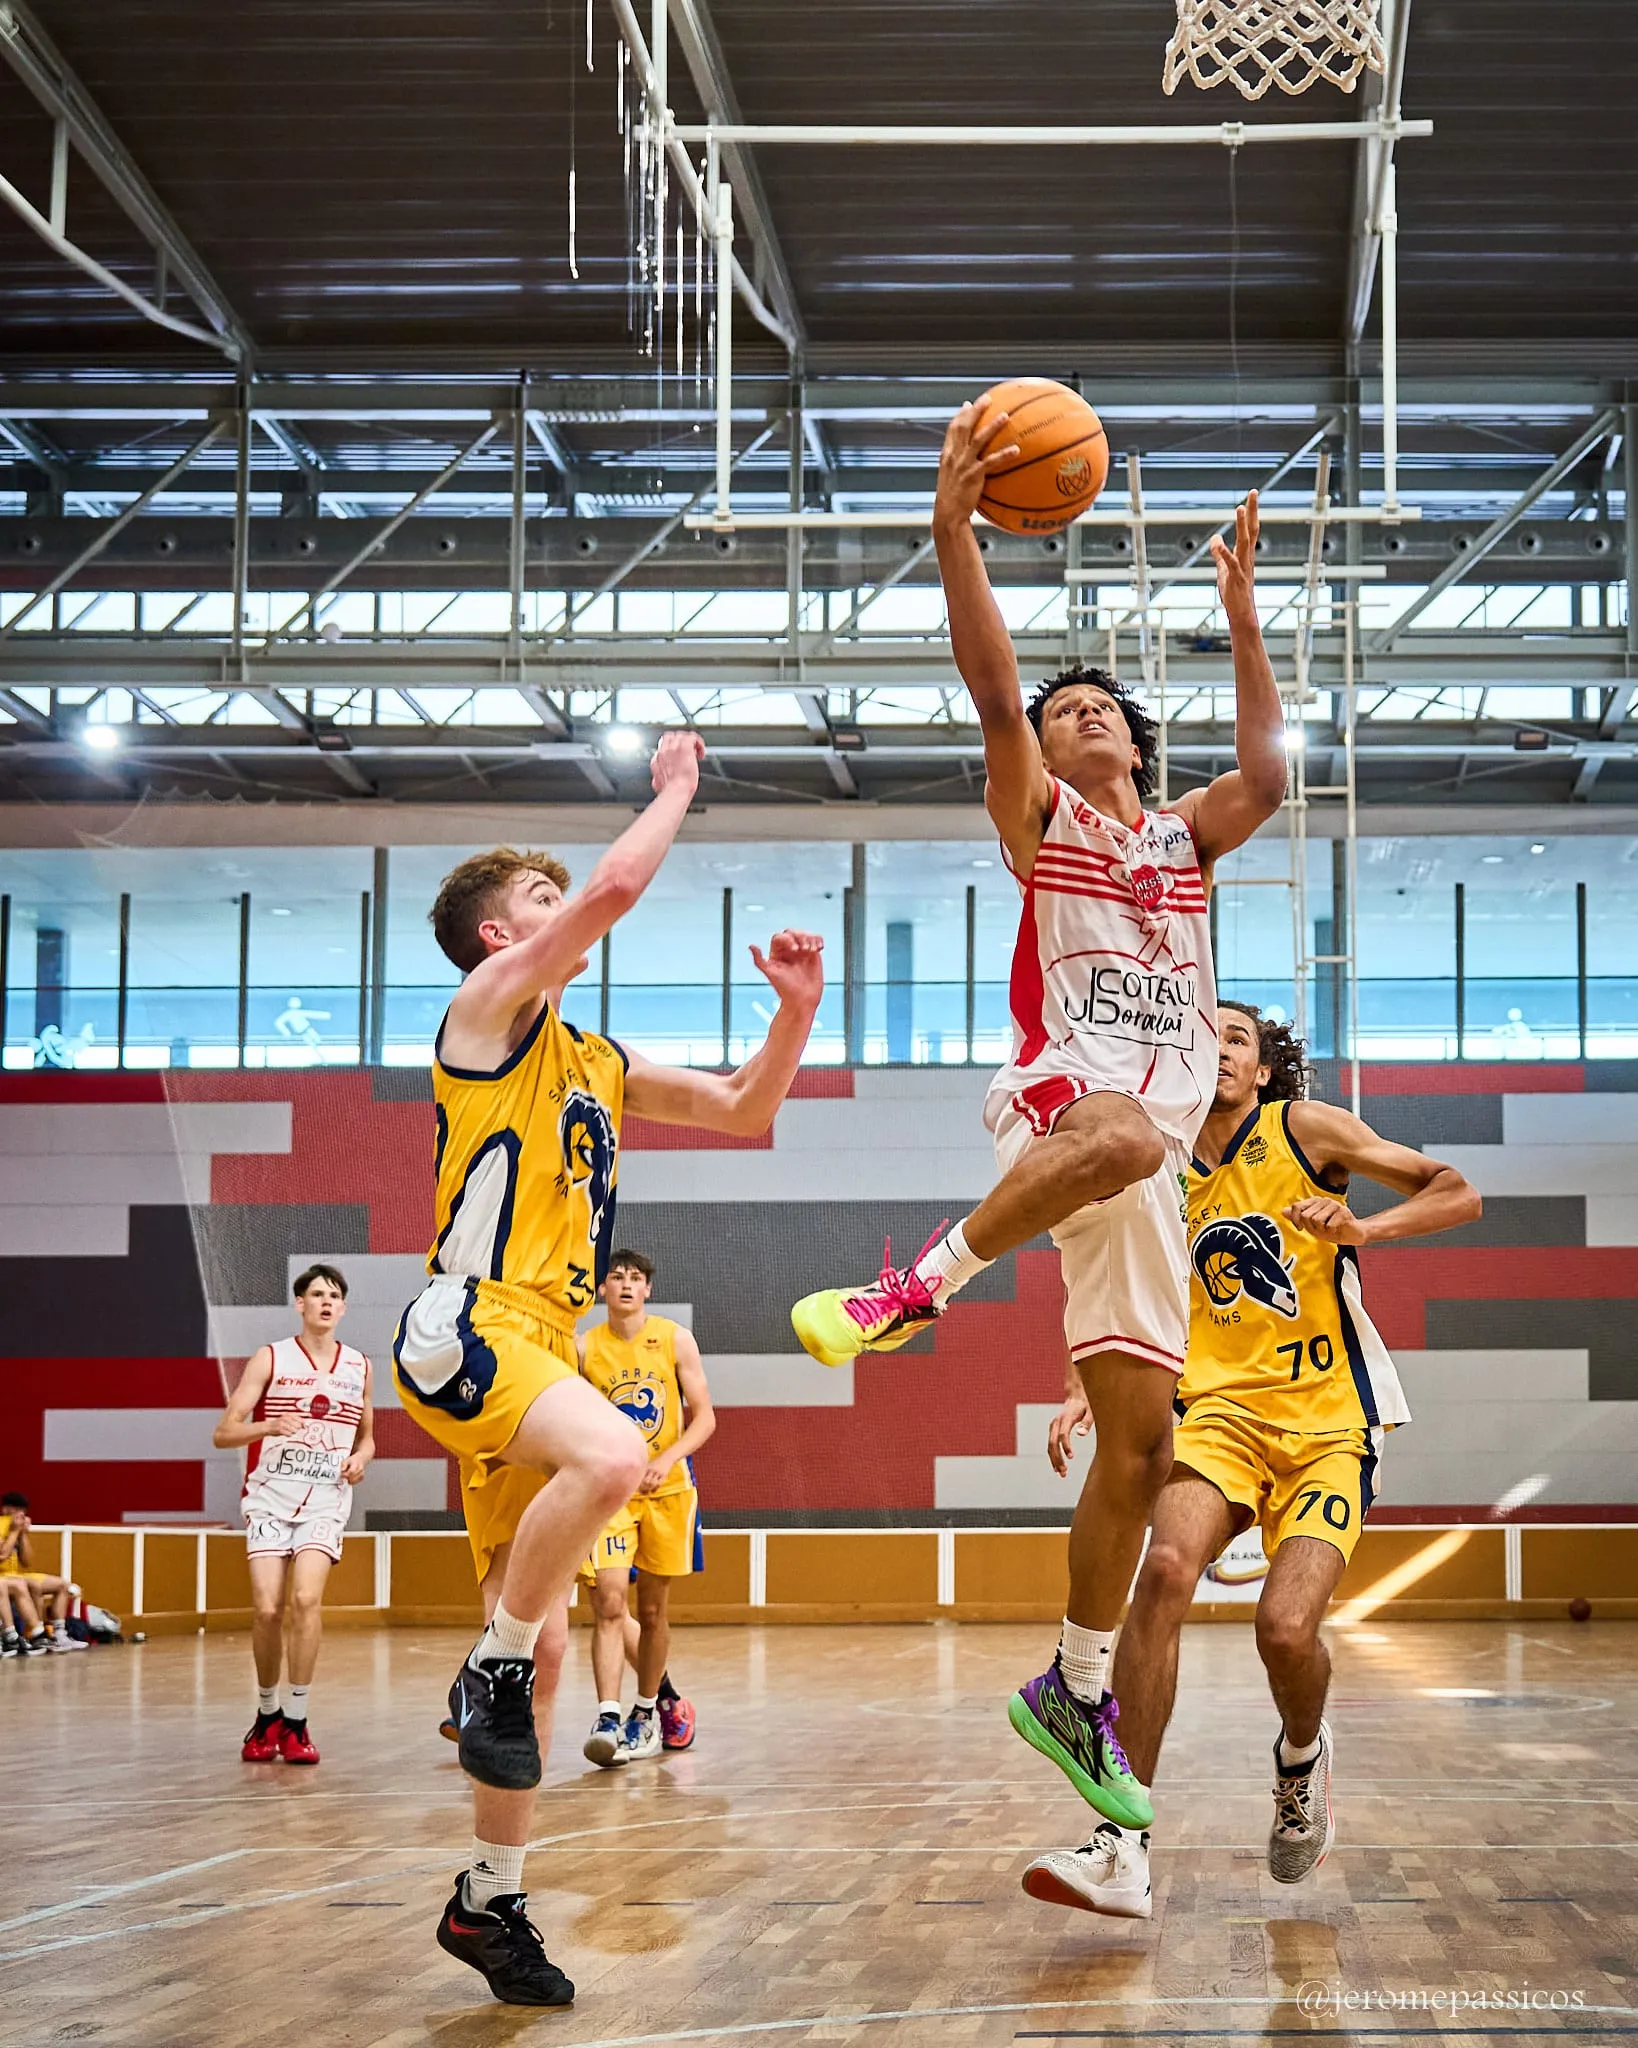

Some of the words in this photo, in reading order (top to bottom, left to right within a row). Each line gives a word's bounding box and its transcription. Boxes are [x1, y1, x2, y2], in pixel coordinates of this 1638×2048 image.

[1276, 1334, 1334, 1381] 70
[1296, 1490, 1350, 1531] 70
[606, 1536, 626, 1555] 14
